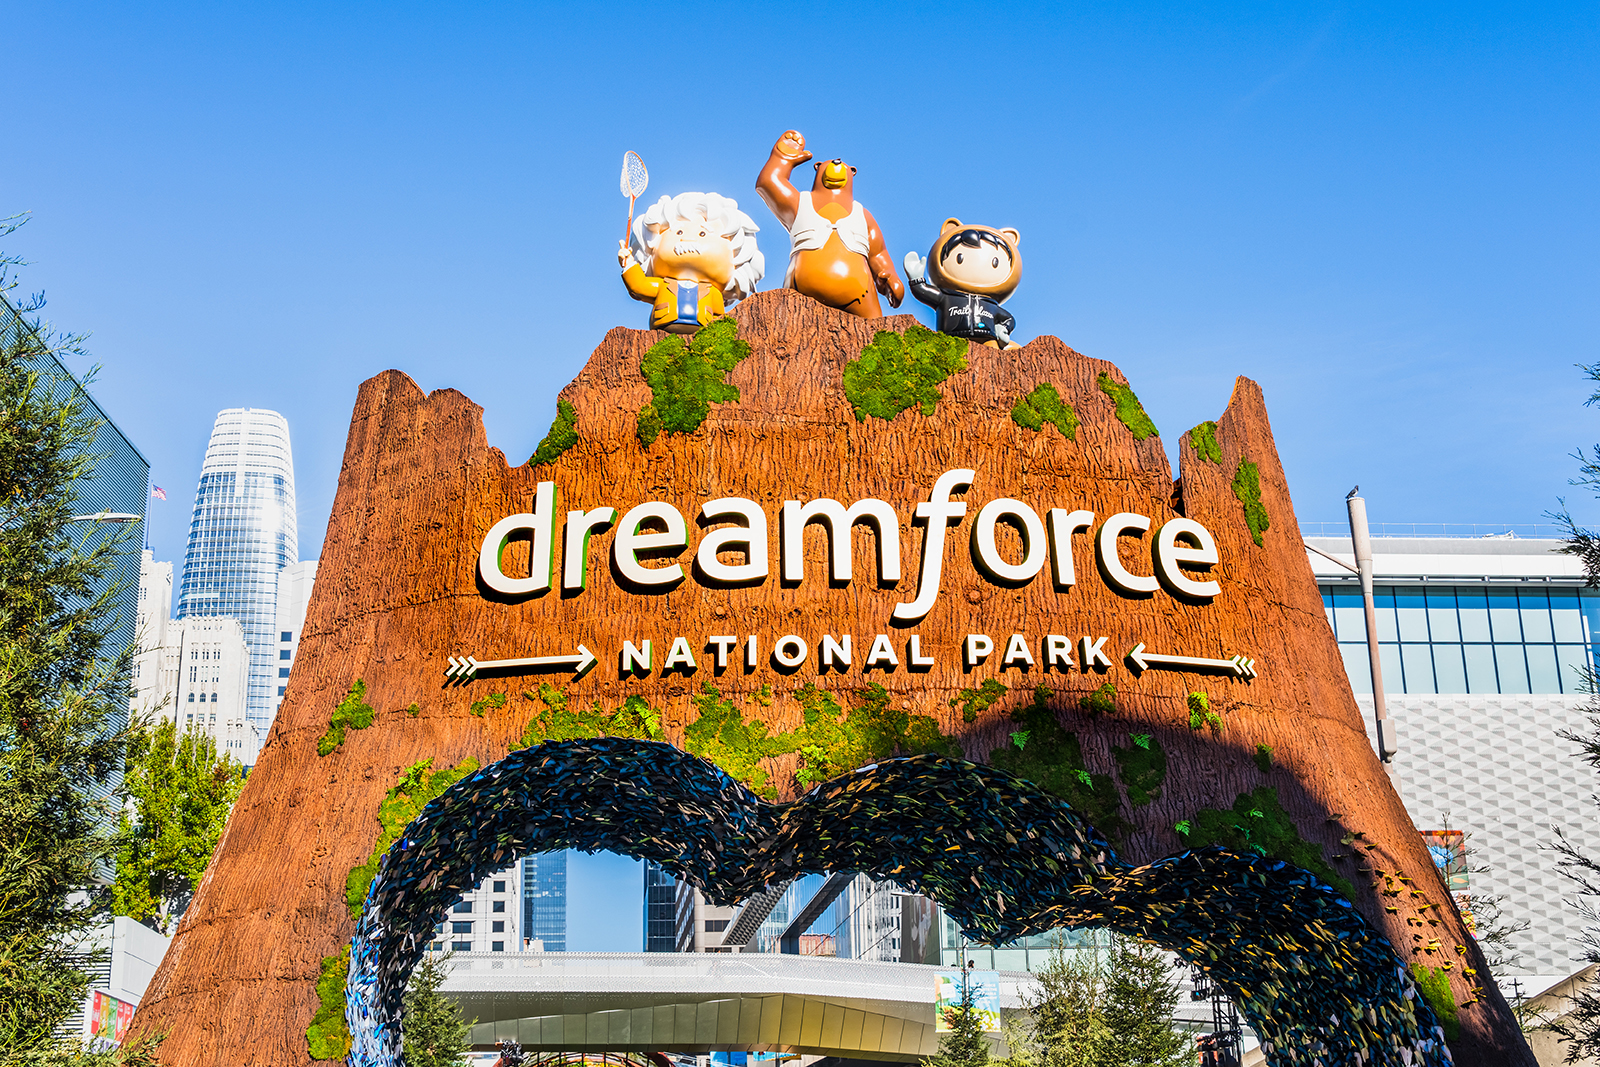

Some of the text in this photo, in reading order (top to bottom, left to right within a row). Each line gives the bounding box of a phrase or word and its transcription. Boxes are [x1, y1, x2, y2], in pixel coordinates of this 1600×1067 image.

[479, 468, 1222, 621] dreamforce
[621, 633, 1112, 672] NATIONAL PARK
